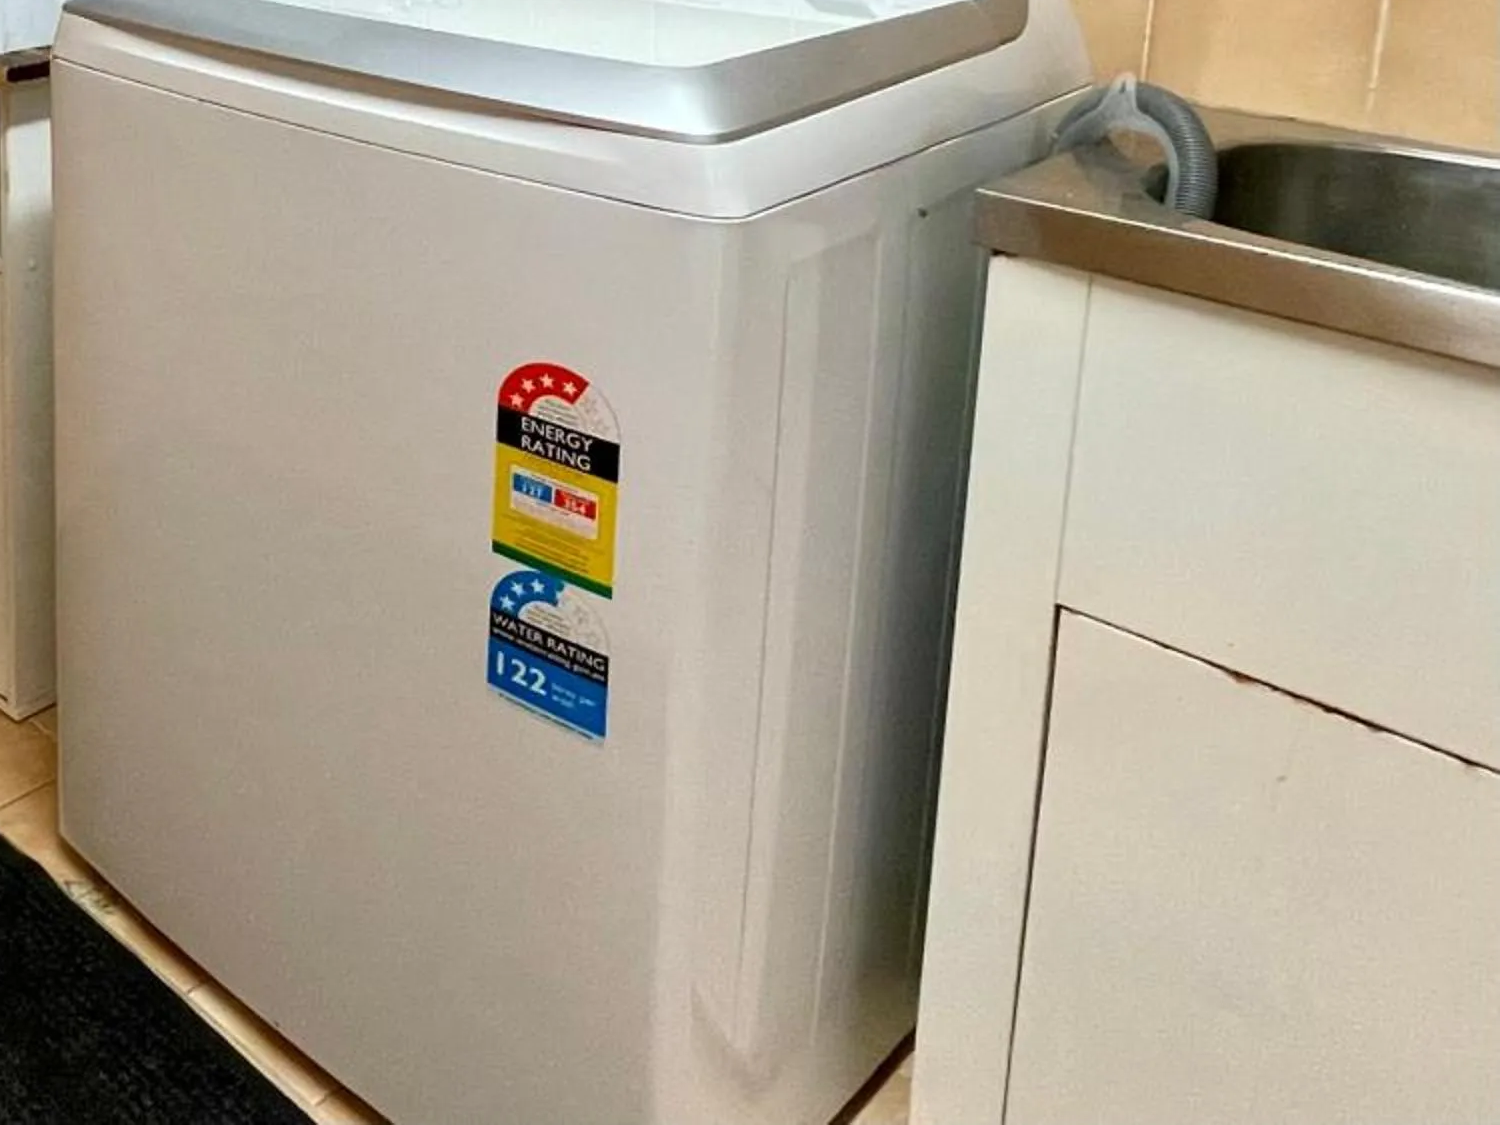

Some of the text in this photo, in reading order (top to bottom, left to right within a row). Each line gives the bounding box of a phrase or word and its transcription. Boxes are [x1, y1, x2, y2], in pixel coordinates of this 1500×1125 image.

[521, 416, 593, 452] ENERGY
[521, 435, 592, 472] RATING
[492, 612, 544, 645] WATER
[547, 637, 605, 672] RATING
[497, 650, 547, 696] 122
